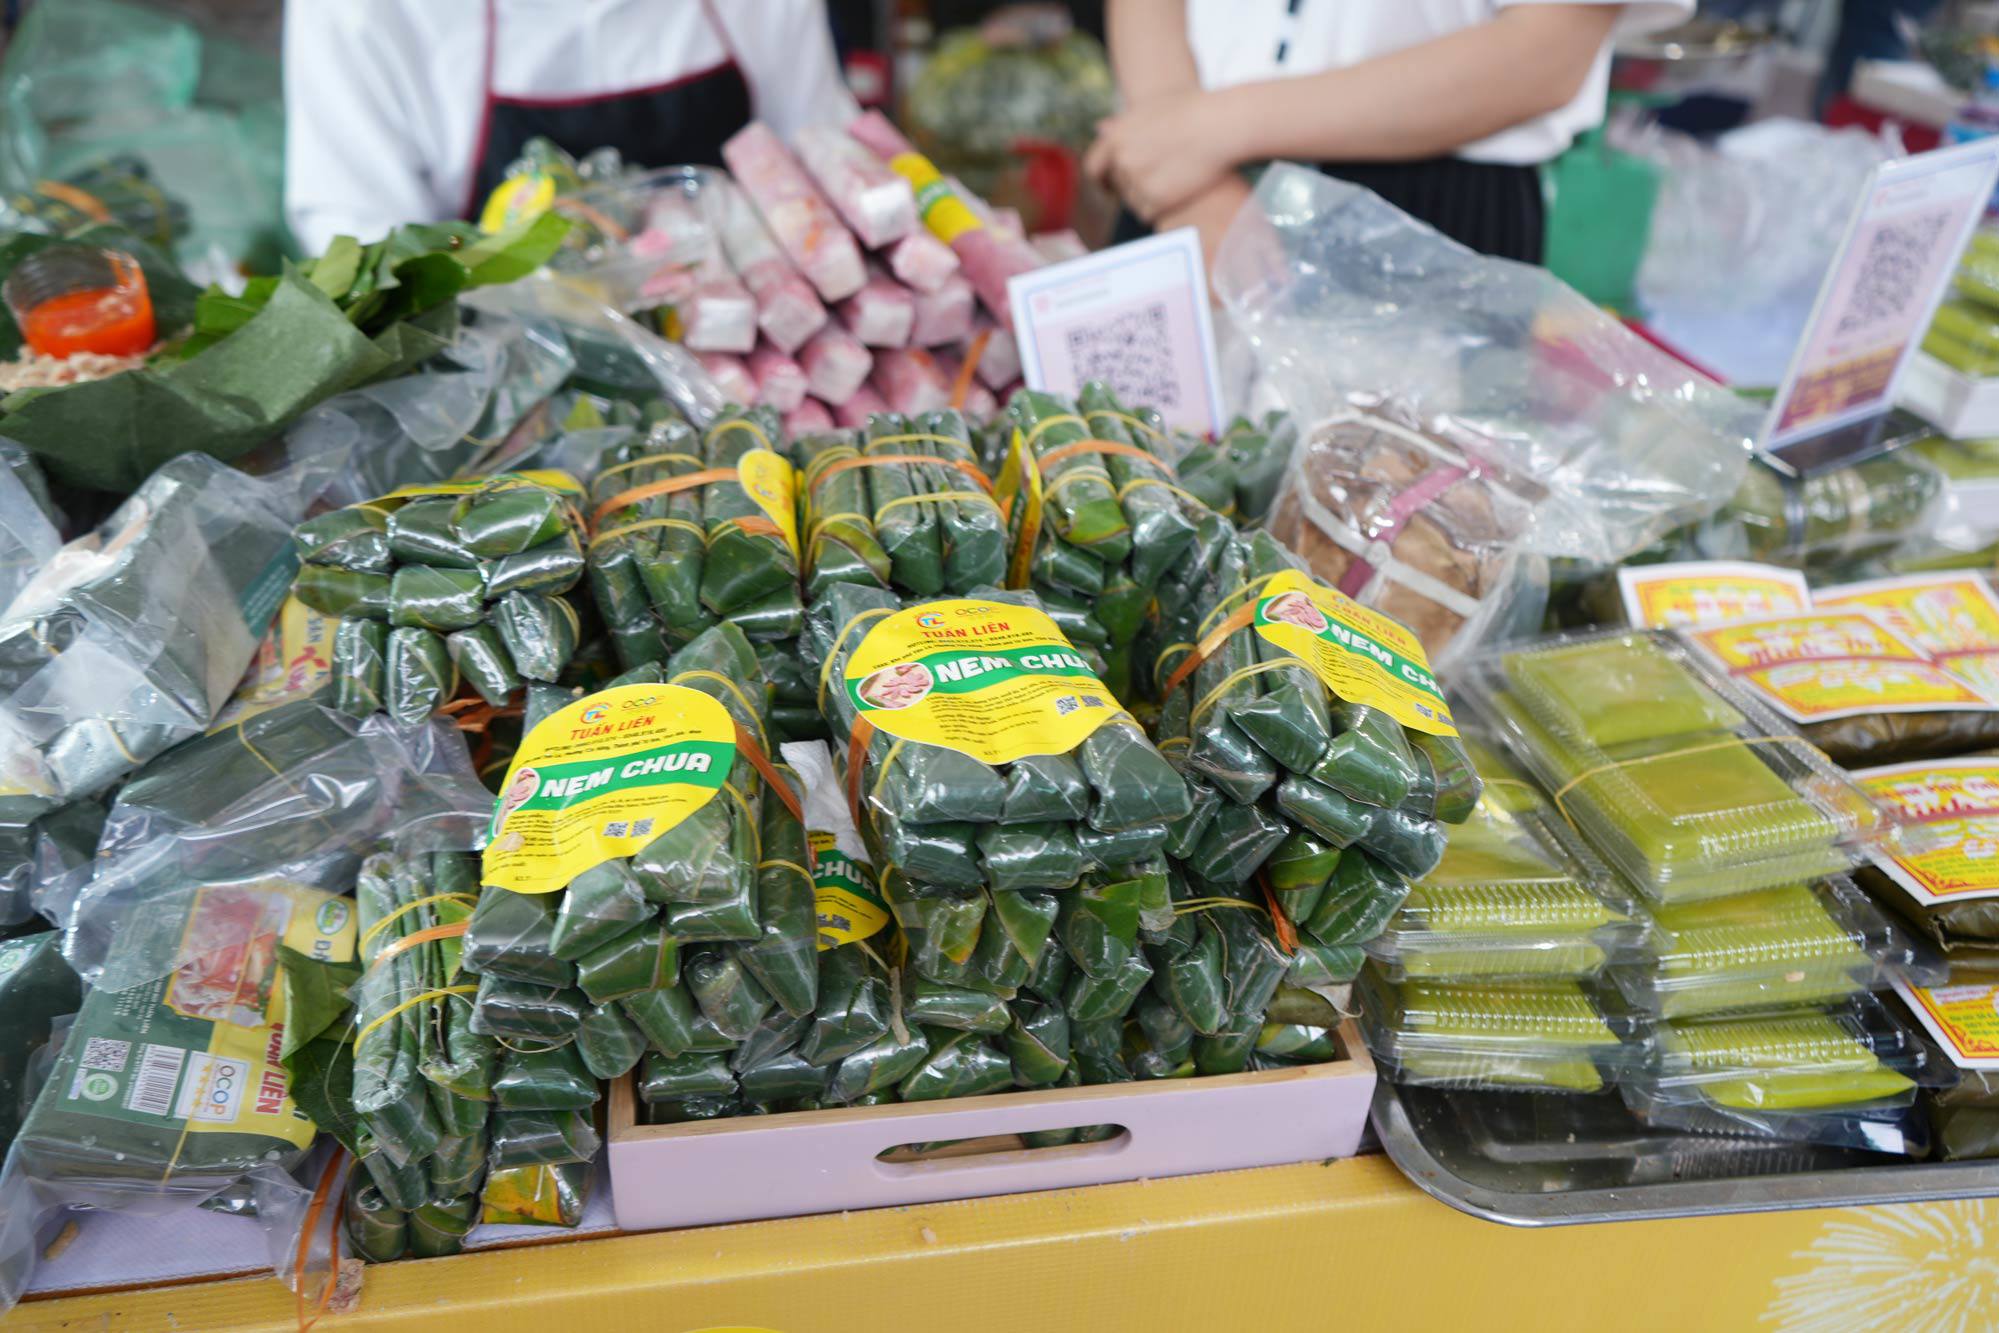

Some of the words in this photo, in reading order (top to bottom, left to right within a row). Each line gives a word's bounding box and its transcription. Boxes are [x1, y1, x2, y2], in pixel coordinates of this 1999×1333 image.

[972, 621, 1010, 636] LIÊN
[1330, 622, 1394, 667] NEM
[933, 655, 1013, 684] NEM
[571, 721, 614, 741] TUẤN
[617, 714, 656, 732] LIÊN
[540, 767, 615, 798] NEM
[620, 752, 712, 779] CHUA
[210, 1065, 236, 1115] OCOP
[255, 1070, 289, 1114] LIÊN
